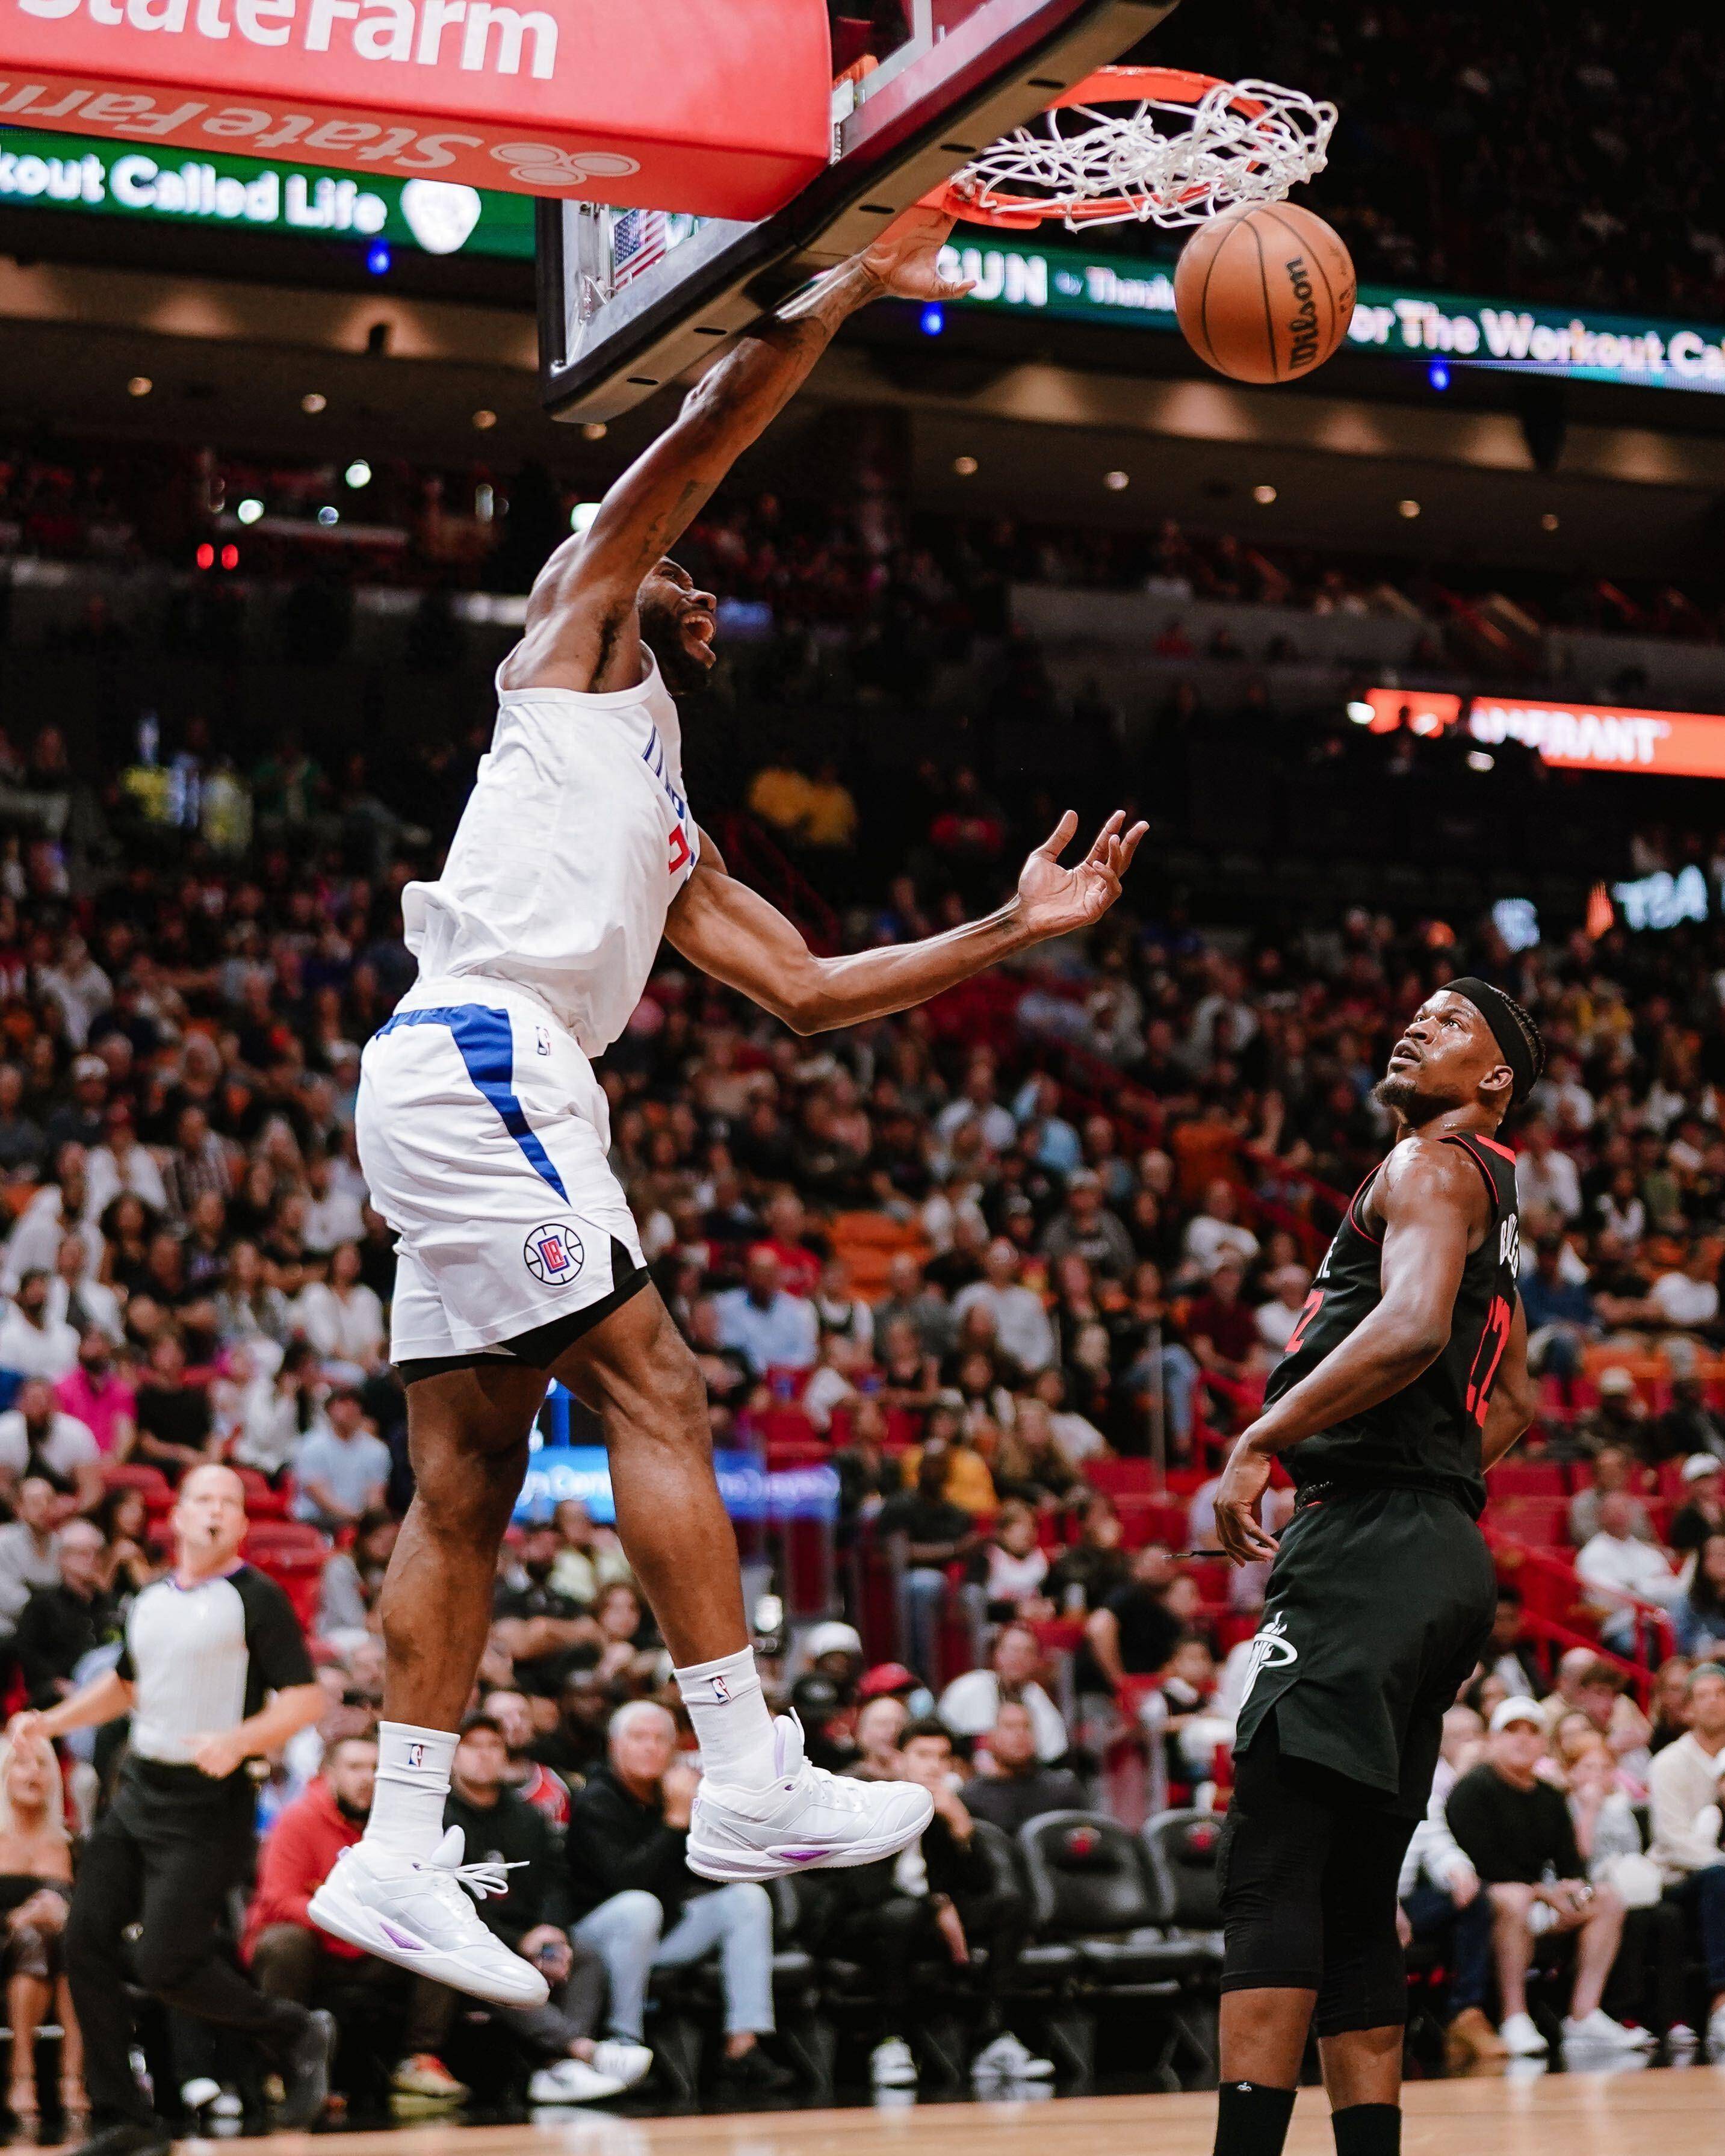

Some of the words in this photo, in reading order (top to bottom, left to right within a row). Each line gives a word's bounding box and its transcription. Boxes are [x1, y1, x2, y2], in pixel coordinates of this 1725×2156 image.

[109, 153, 279, 223] Called
[285, 173, 388, 234] Life
[1286, 255, 1319, 371] Wilson
[1393, 299, 1480, 354] The
